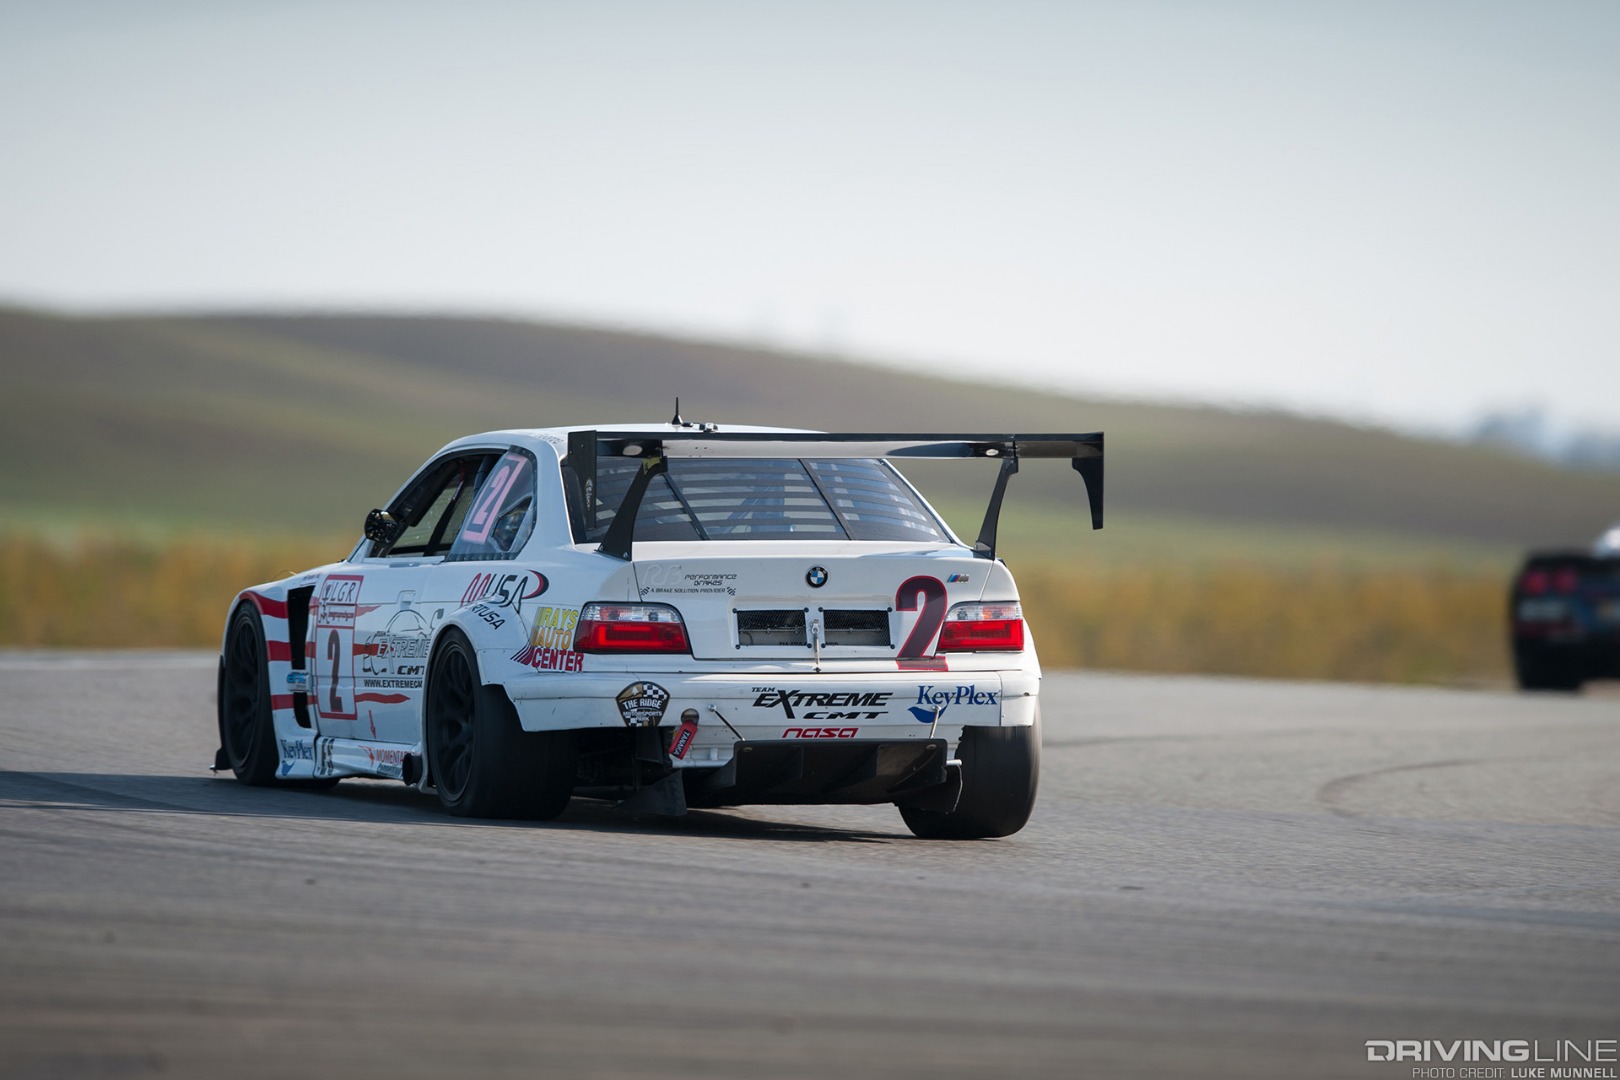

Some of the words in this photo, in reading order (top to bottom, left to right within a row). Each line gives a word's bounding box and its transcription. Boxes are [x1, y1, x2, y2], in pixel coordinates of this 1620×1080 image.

[473, 465, 510, 524] 2
[540, 606, 579, 630] RAYS
[895, 575, 949, 672] 2
[536, 627, 573, 650] AUTO
[327, 629, 343, 712] 2
[531, 647, 585, 672] CENTER
[623, 700, 639, 710] THE
[639, 699, 663, 709] RIDGE
[752, 690, 893, 719] EXTREME
[917, 685, 997, 708] KeyPlex
[803, 711, 889, 720] CMT
[673, 730, 691, 756] TANAKA
